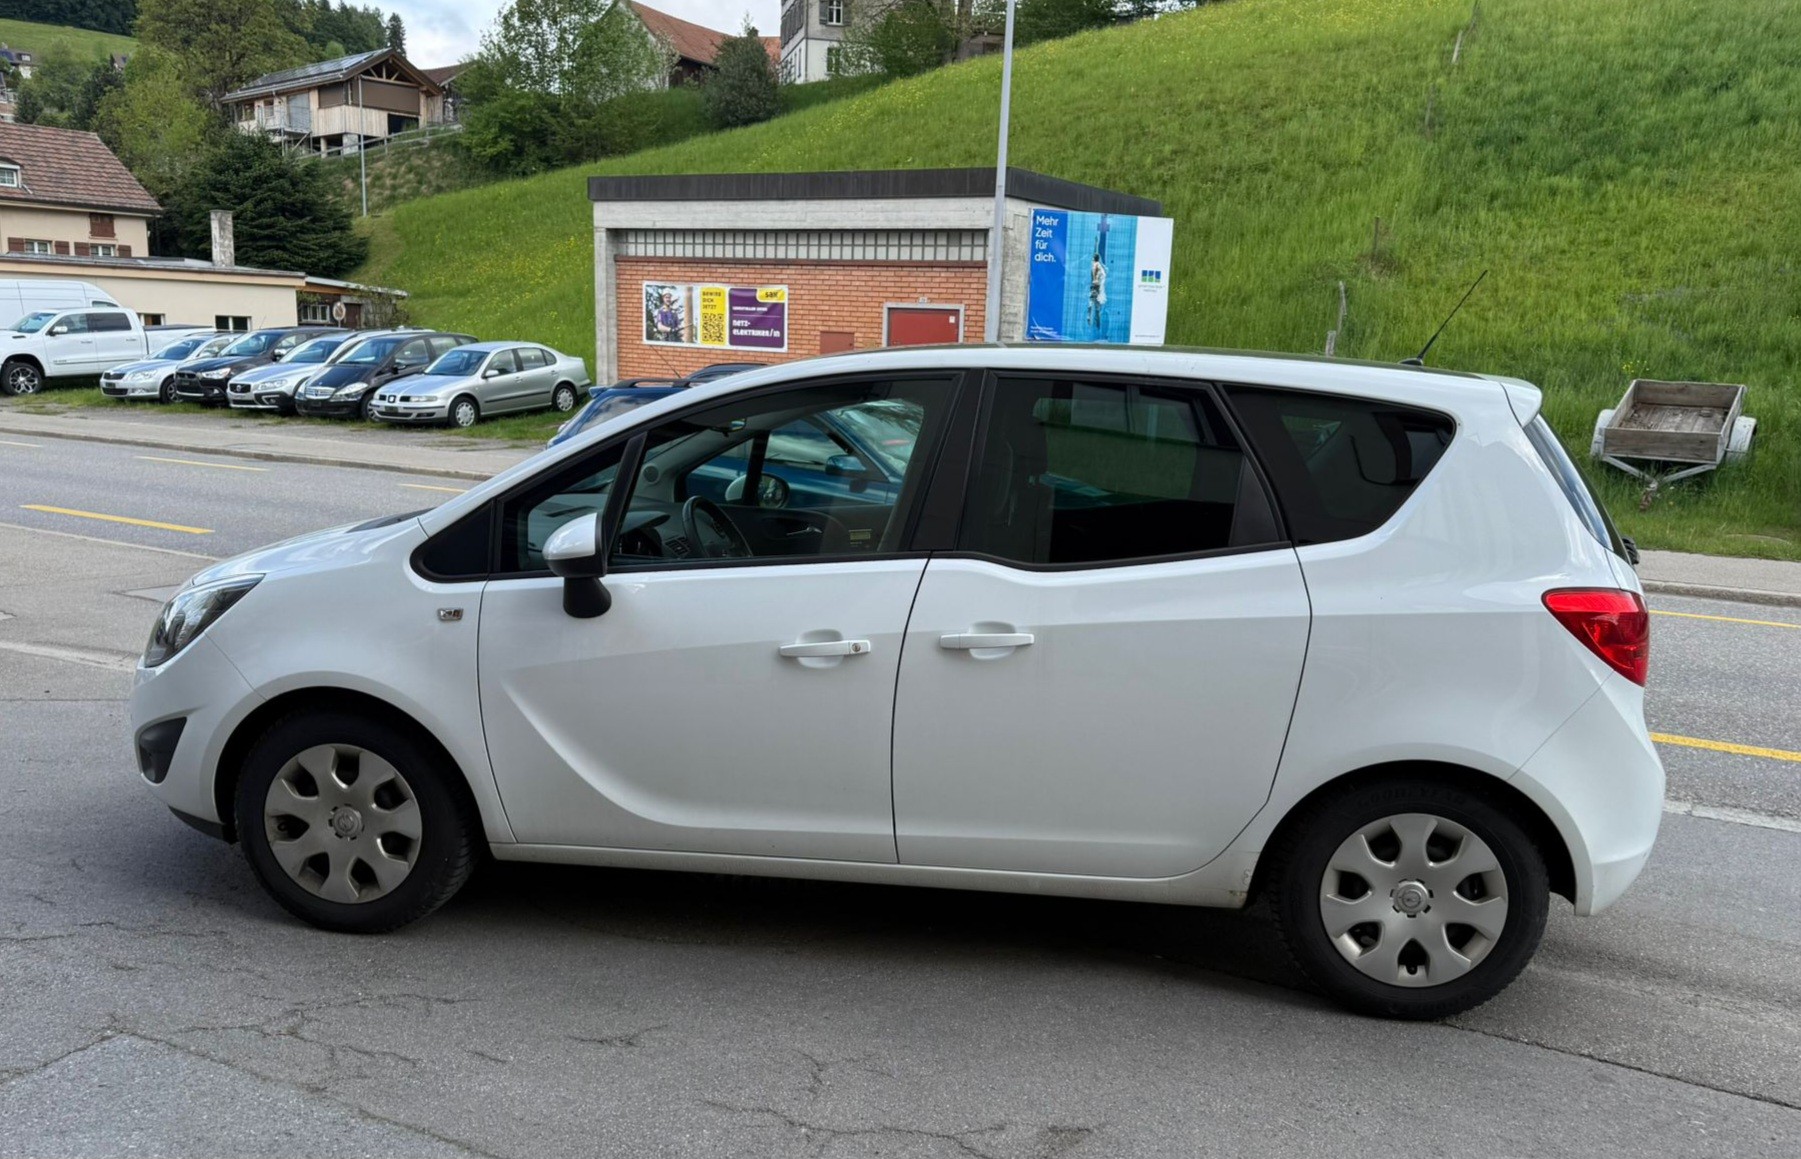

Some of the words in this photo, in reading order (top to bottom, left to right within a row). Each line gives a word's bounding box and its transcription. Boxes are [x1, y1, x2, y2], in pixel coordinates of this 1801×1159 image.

[1036, 215, 1058, 226] Mehr
[1035, 227, 1053, 238] Zeit
[1035, 240, 1048, 250] für
[1034, 252, 1056, 263] dich.
